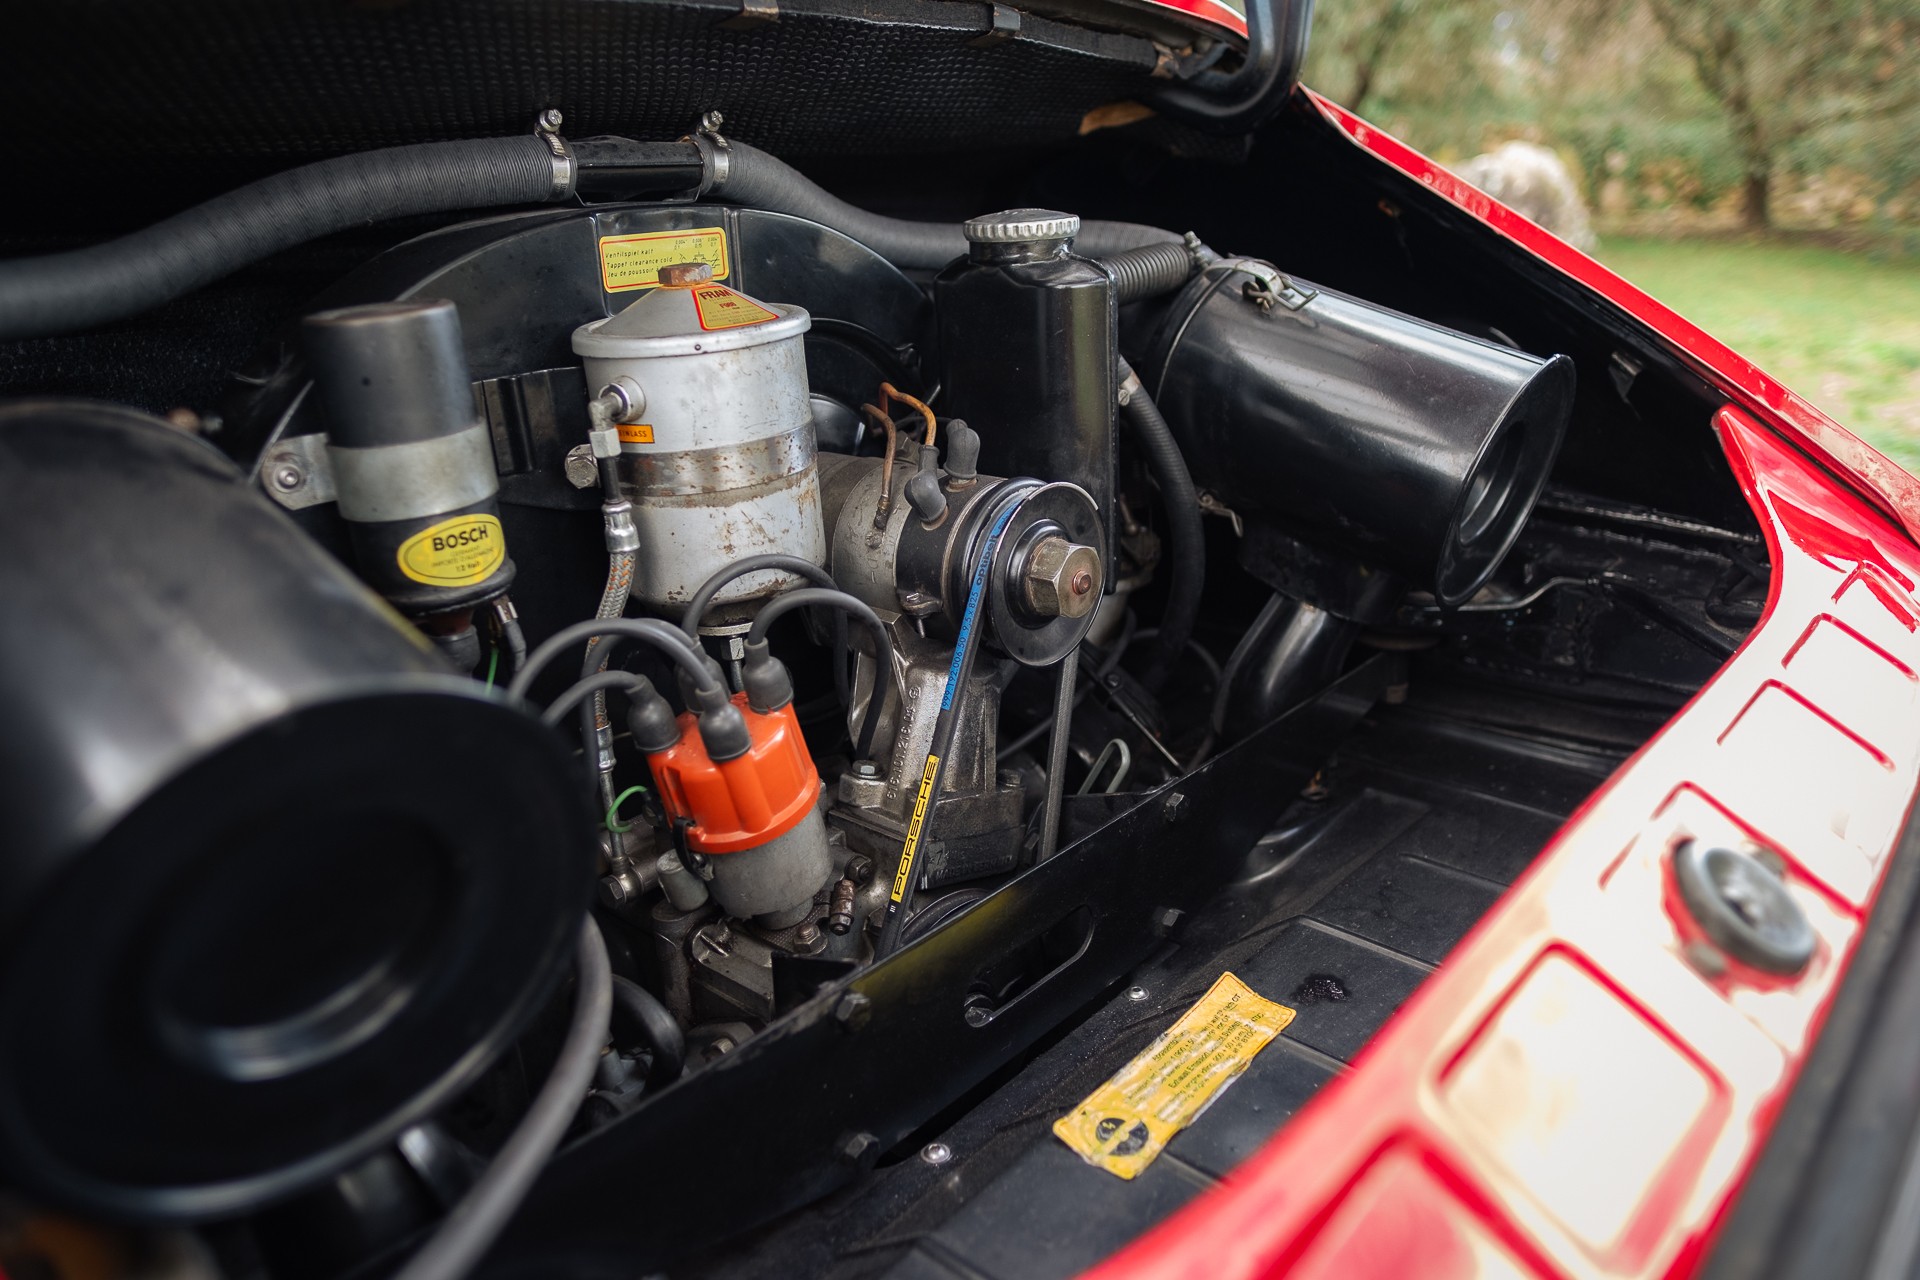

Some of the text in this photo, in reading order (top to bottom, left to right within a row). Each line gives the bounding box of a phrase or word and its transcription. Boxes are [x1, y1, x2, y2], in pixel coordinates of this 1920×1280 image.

[605, 250, 639, 258] Ventilspiel
[607, 261, 627, 269] Tappet
[630, 258, 658, 267] clearance
[628, 267, 654, 276] poussoir
[699, 289, 733, 300] FRAM
[432, 524, 488, 551] BOSCH
[942, 637, 966, 707] 999.192.006.50
[968, 591, 979, 608] 825
[976, 534, 998, 586] optibelt
[894, 762, 935, 895] PORSCHE
